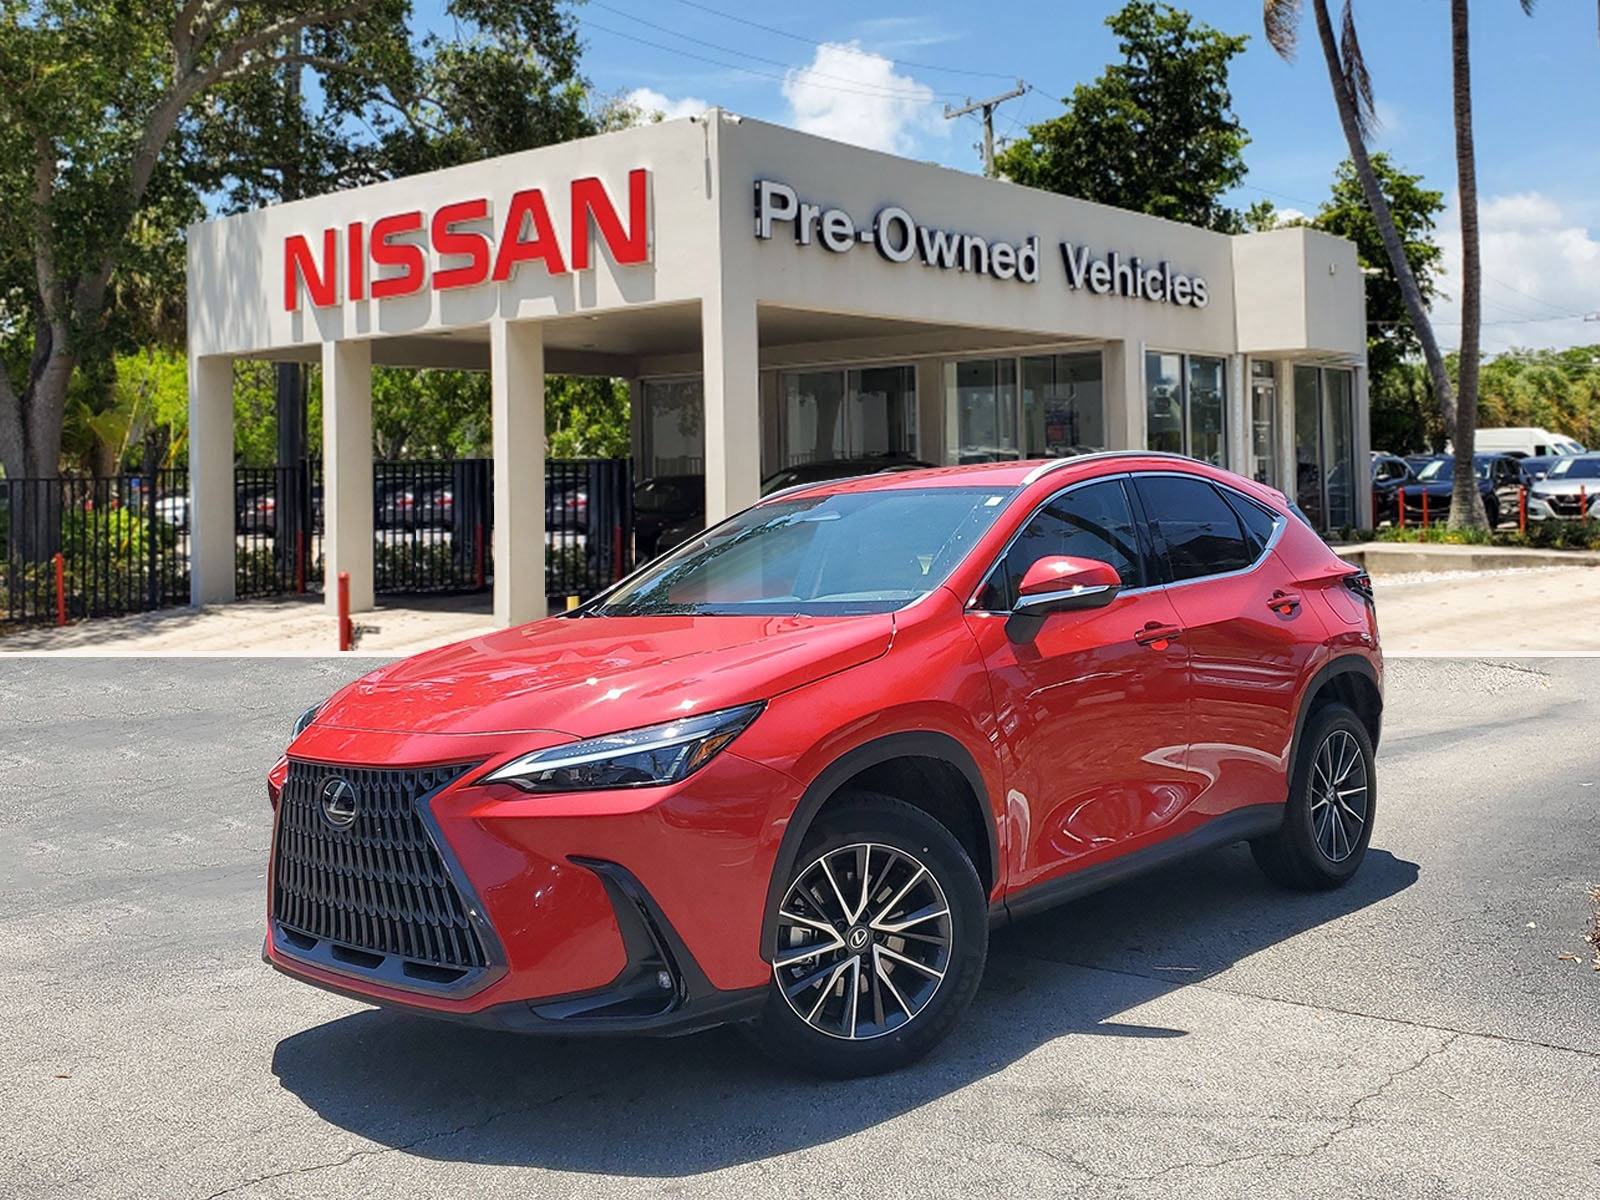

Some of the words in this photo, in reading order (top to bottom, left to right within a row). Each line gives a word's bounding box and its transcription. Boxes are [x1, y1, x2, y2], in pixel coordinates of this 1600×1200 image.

[284, 168, 648, 312] NISSAN
[755, 180, 1040, 283] Pre-Owned
[1061, 241, 1209, 308] Vehicles
